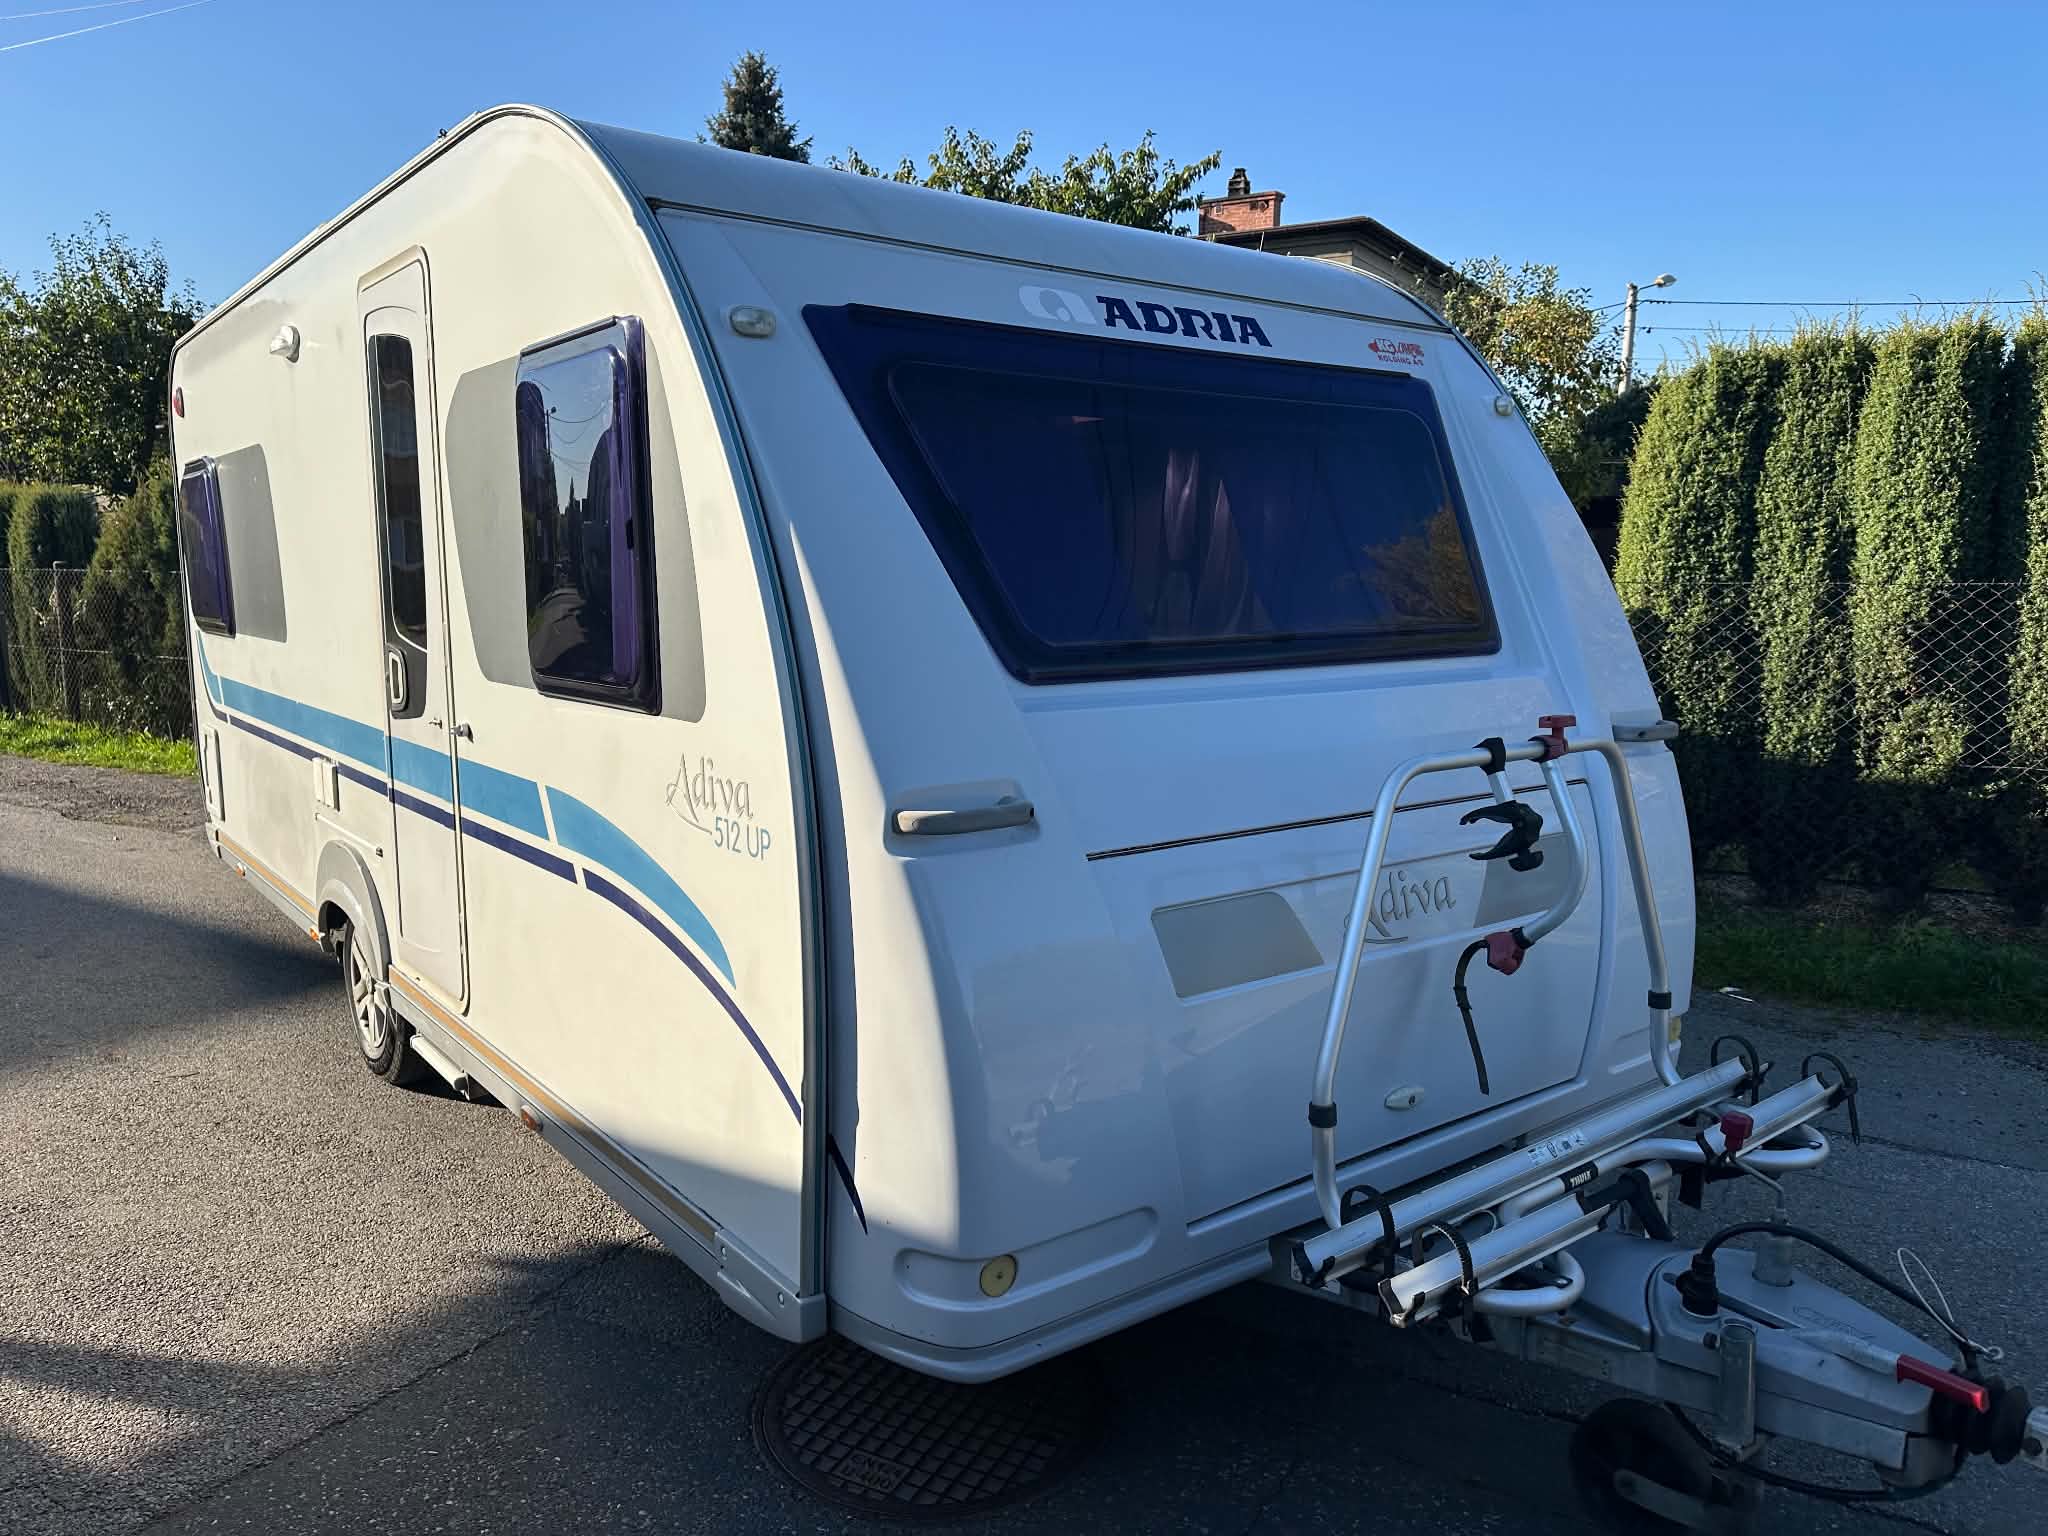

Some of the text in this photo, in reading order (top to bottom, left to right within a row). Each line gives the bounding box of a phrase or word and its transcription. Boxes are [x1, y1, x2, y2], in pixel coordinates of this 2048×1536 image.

[1095, 295, 1273, 347] ADRIA
[665, 752, 754, 835] Adiva
[714, 816, 771, 860] 512 UP
